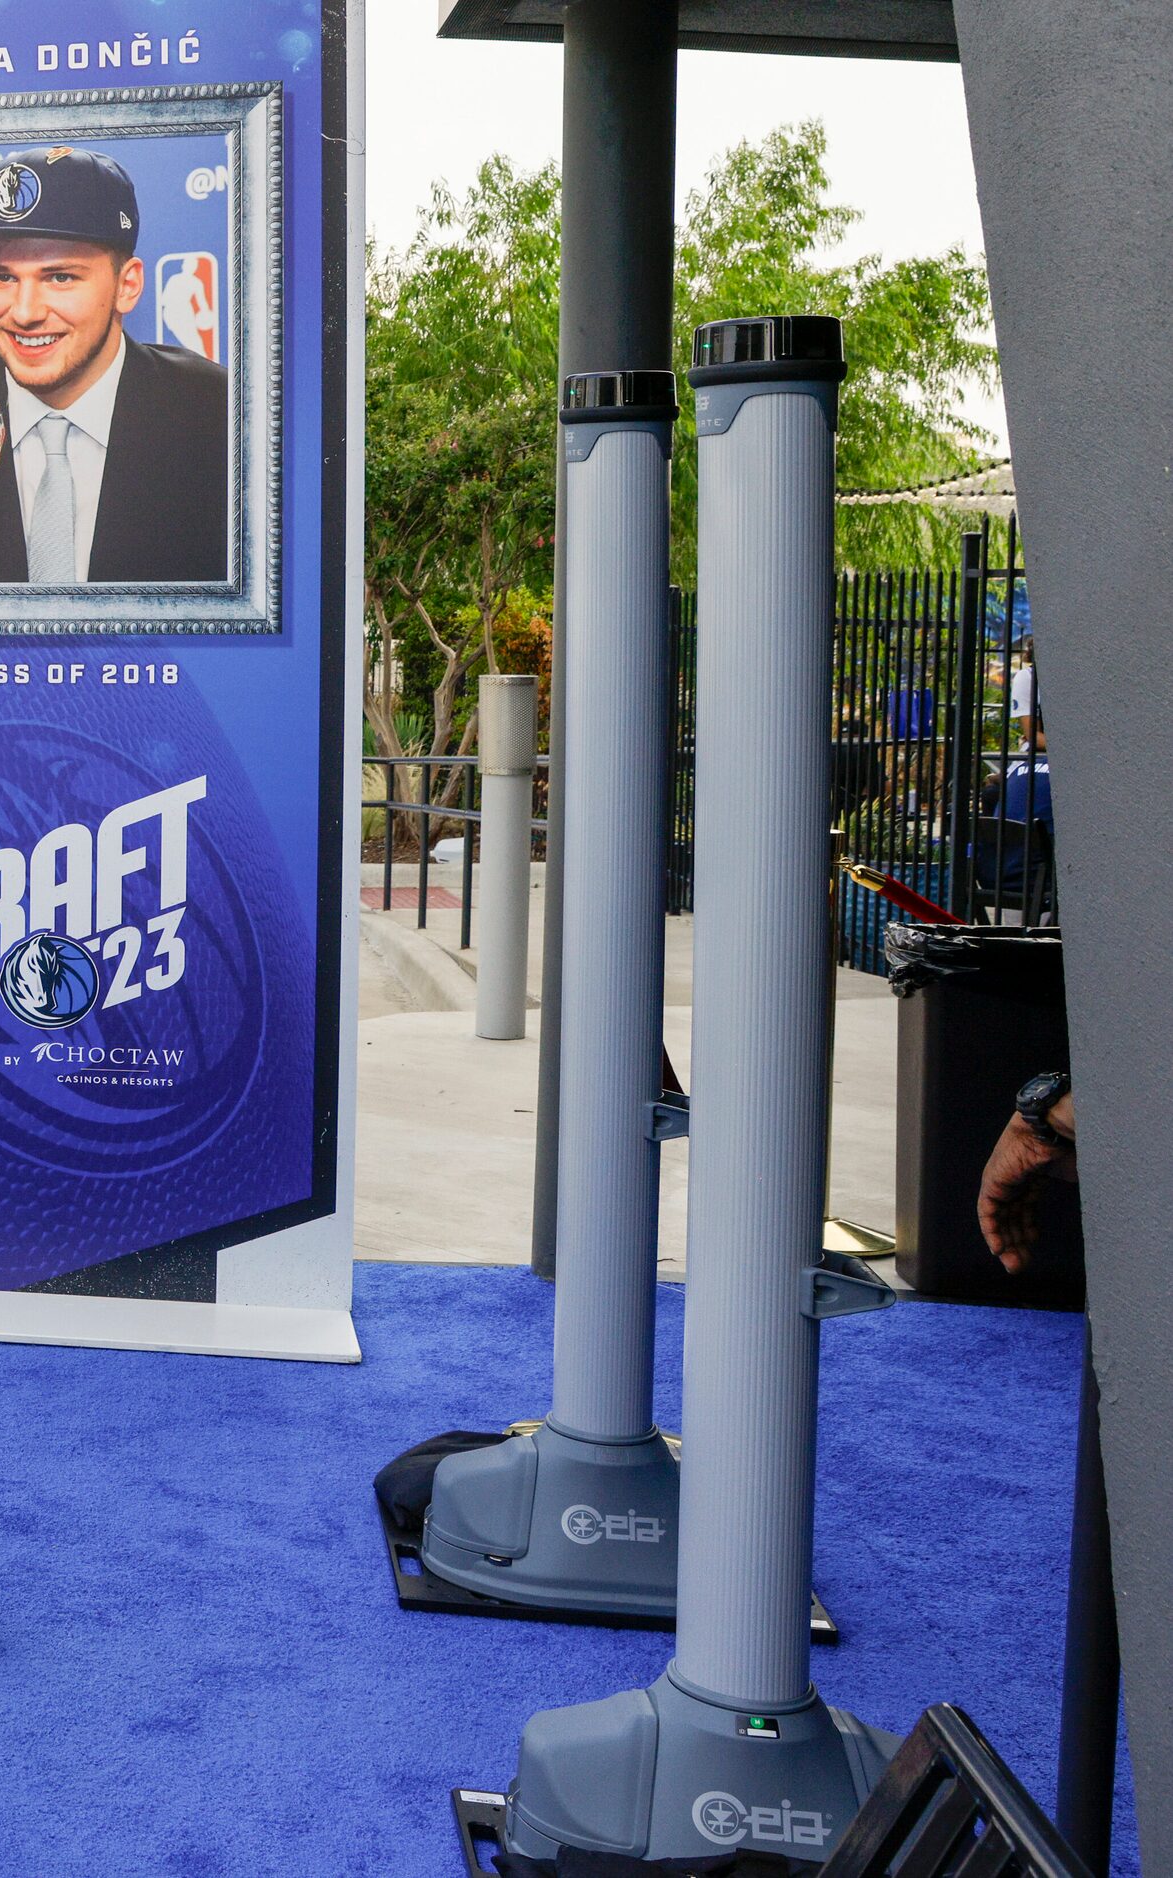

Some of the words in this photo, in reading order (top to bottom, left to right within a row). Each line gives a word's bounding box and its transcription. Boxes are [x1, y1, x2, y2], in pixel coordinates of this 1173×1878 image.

[37, 29, 201, 71] DONČIĆ
[47, 664, 85, 684] OF
[102, 664, 178, 684] 2018
[4, 1056, 21, 1066] BY
[45, 1042, 184, 1066] CHOCTAW
[57, 1075, 108, 1085] CASINOS
[111, 1077, 119, 1085] &
[122, 1078, 174, 1087] RESORTS
